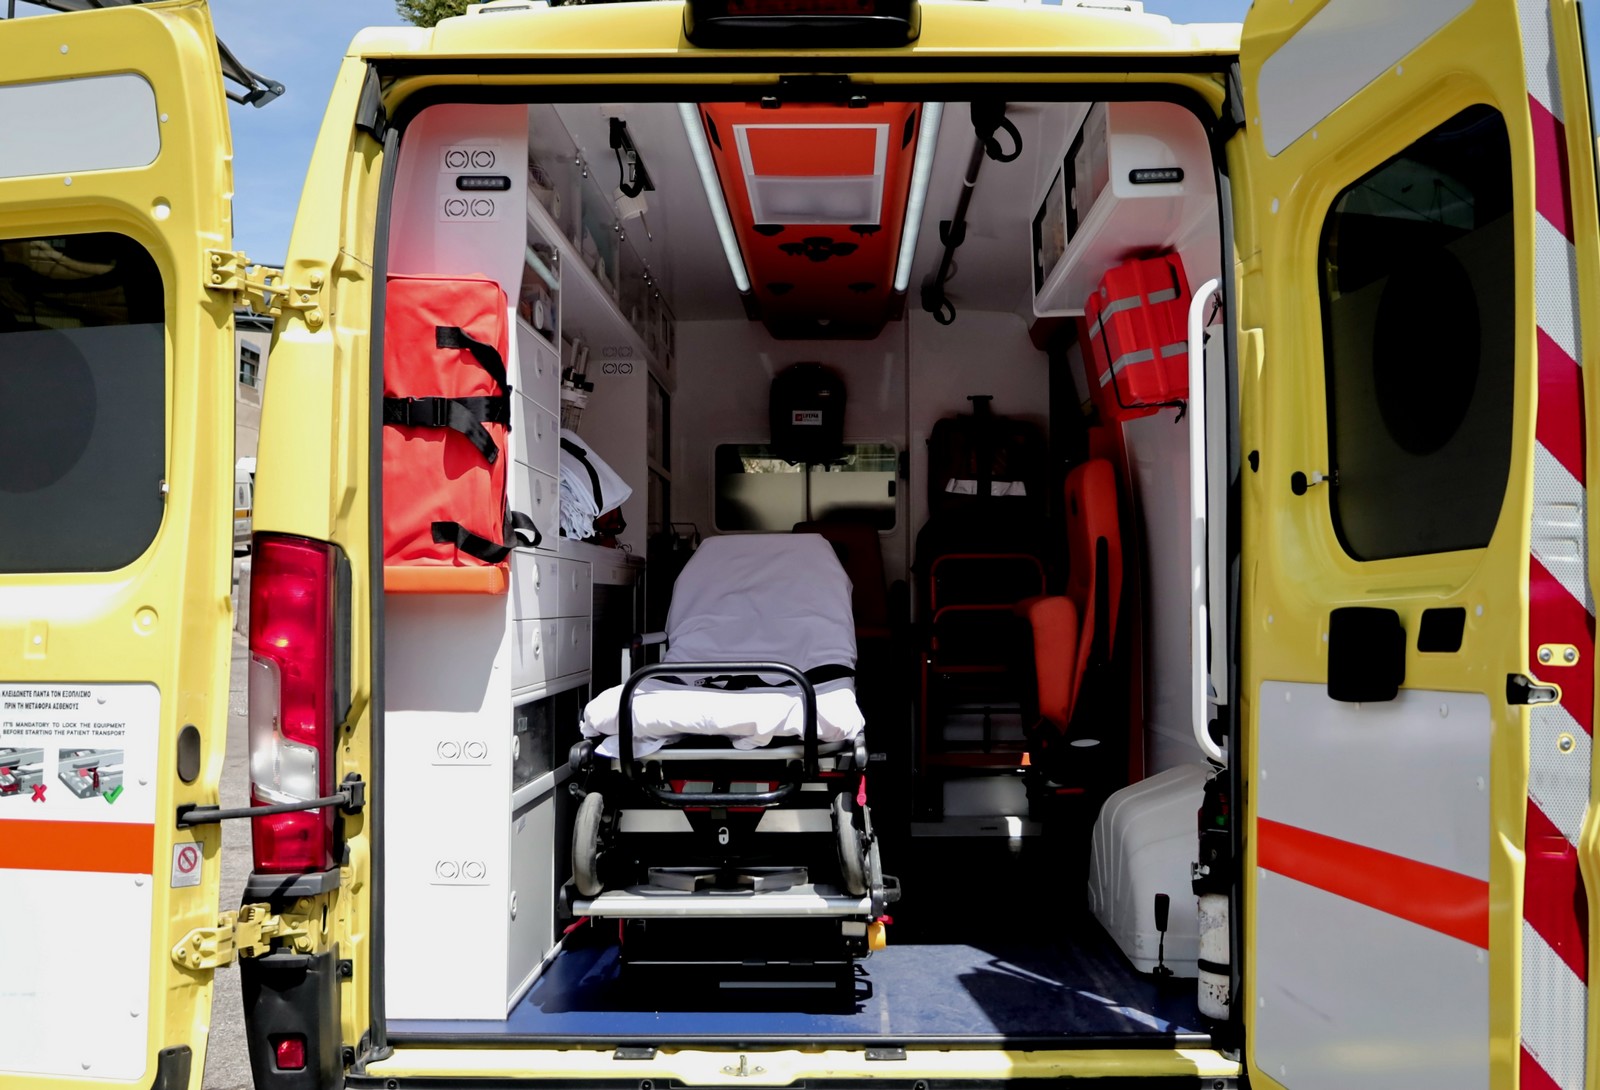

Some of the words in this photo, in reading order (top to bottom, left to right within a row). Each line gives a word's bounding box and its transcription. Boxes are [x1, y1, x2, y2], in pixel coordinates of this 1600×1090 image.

[2, 690, 32, 698] ΚΛΕΙΔΩΝΕΤΕ
[33, 690, 50, 698] ΠΑΝΤΑ
[4, 702, 16, 710] ΠΡΙΝ
[17, 702, 24, 710] ΤΗ
[25, 702, 52, 710] ΜΕΤΑΦΟΡΑ
